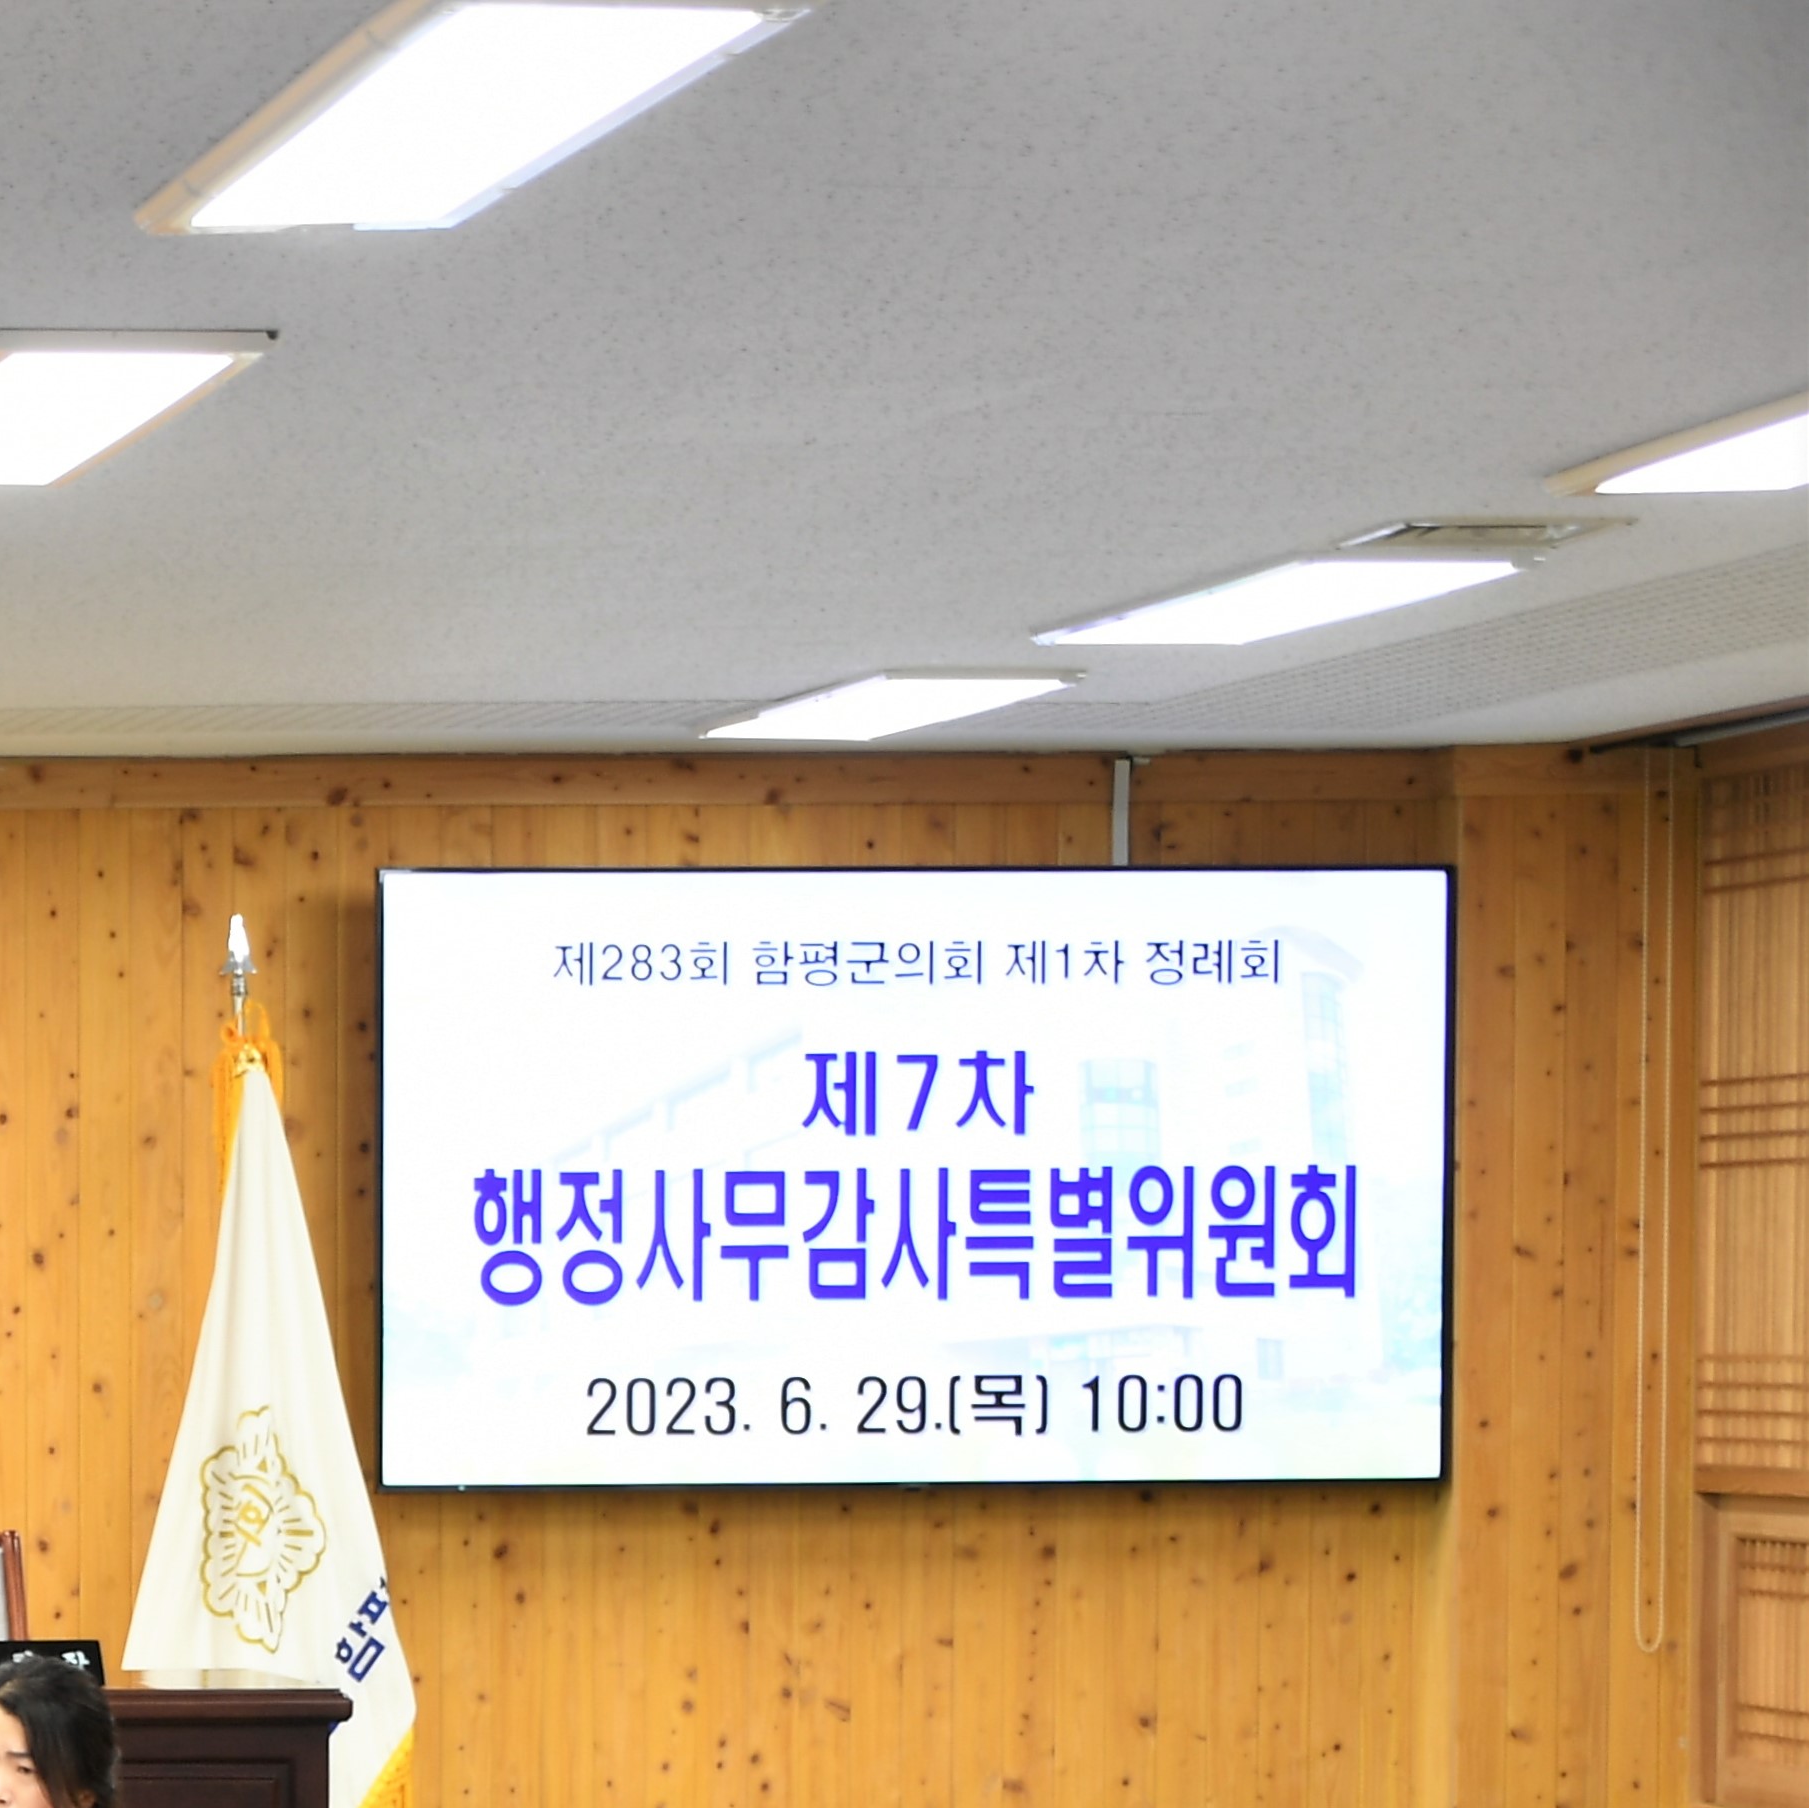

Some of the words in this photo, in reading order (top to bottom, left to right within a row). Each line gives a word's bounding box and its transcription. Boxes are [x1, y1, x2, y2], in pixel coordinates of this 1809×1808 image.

[554, 942, 727, 986] 제283회
[753, 941, 982, 986] 함평군의회
[1006, 940, 1124, 984] 제1차
[1147, 939, 1279, 985] 정례회
[803, 1051, 1034, 1135] 제7차
[475, 1165, 1356, 1306] 행정사무감사특별위원회
[587, 1377, 750, 1435] 2023.
[781, 1377, 826, 1434] 6.
[1082, 1374, 1242, 1433] 10:00
